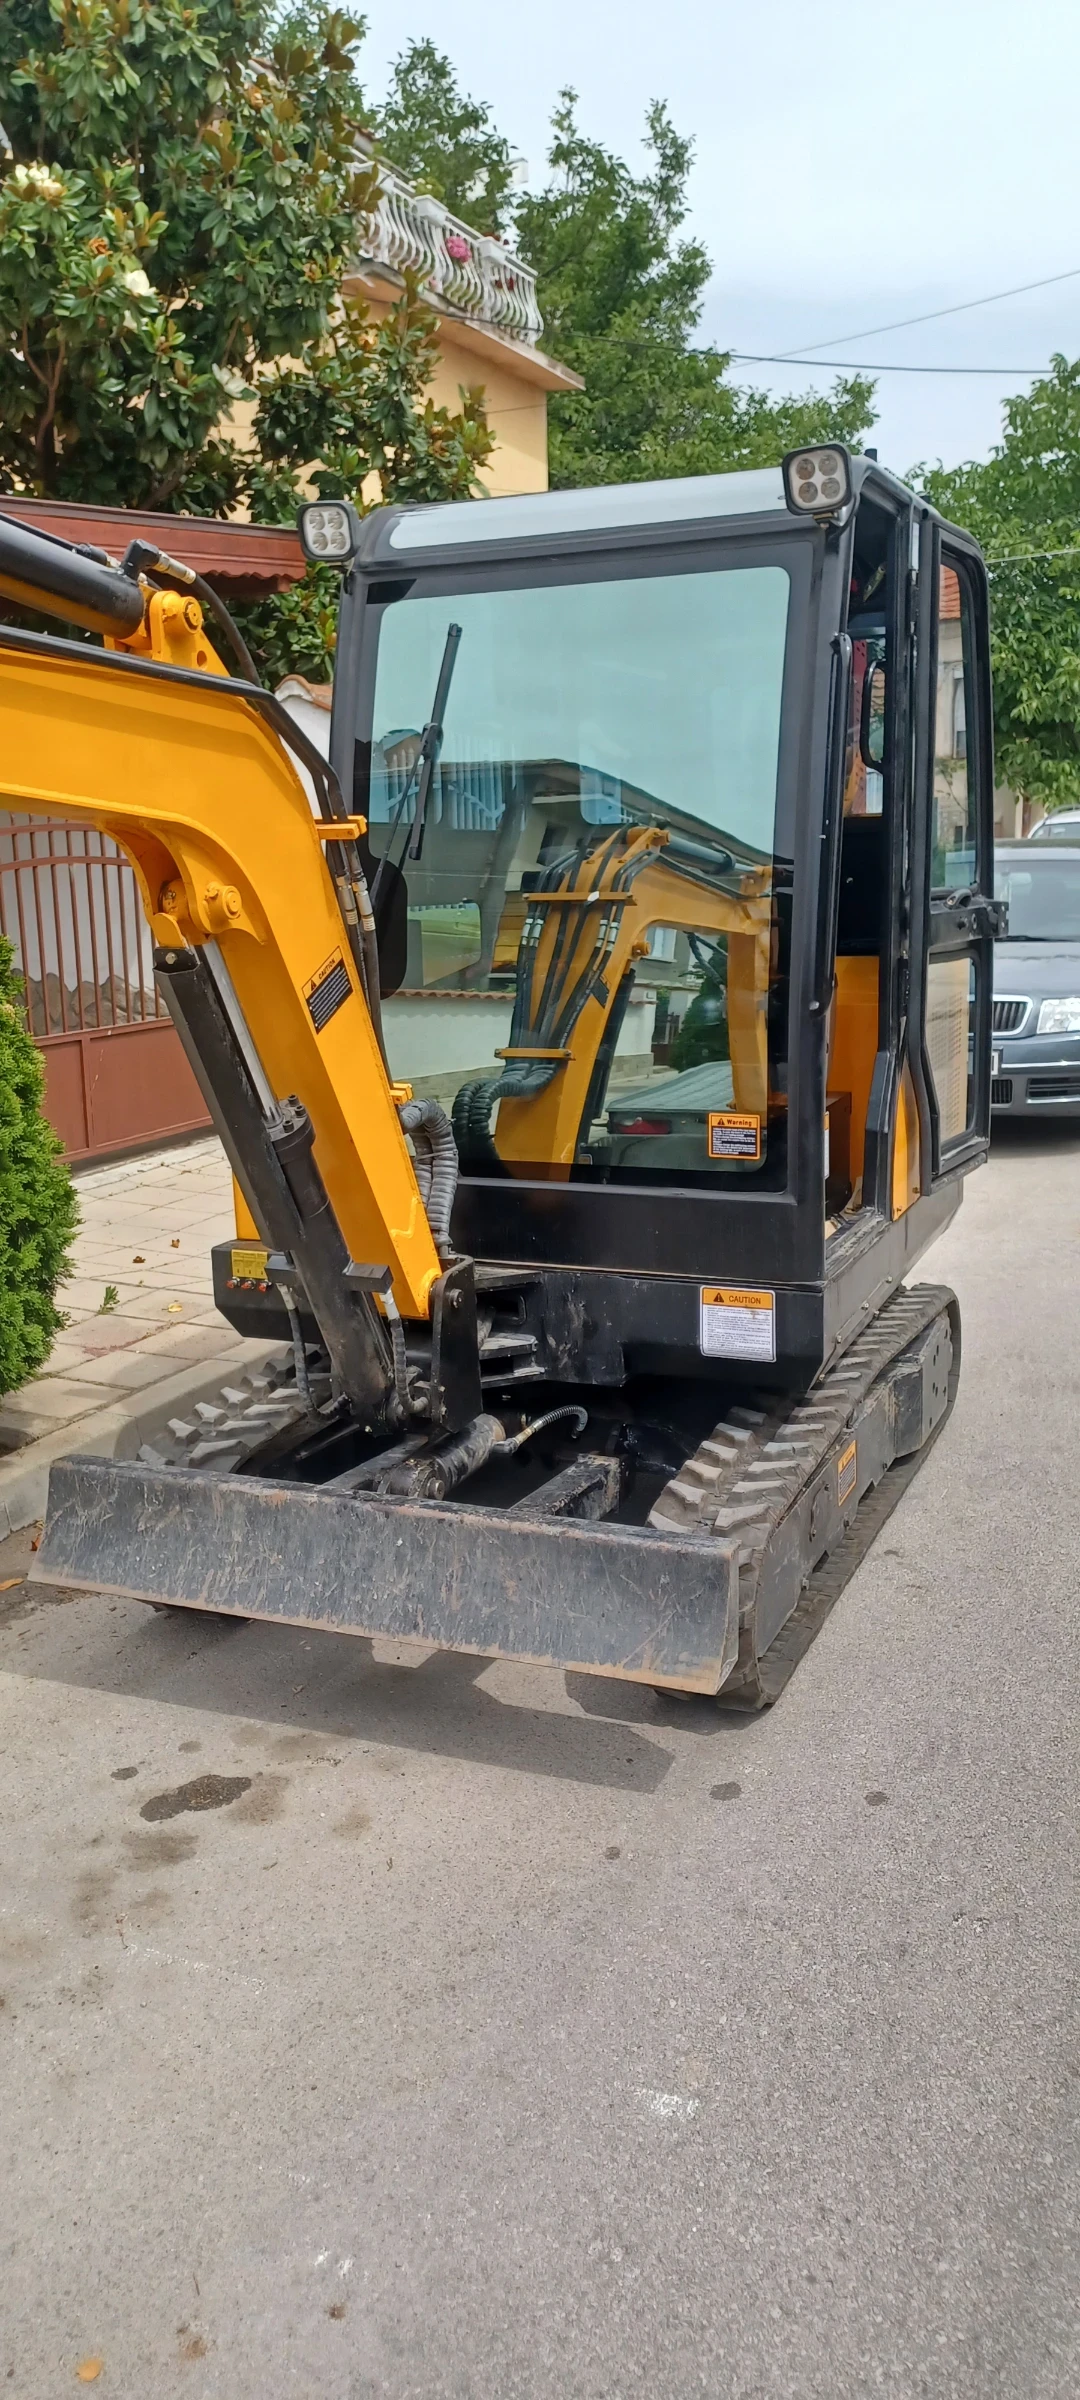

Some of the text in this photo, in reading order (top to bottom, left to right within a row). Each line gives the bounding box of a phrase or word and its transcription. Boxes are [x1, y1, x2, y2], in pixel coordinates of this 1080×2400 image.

[318, 958, 336, 980] CAUTION
[727, 1119, 752, 1127] Warning
[728, 1295, 761, 1305] CAUTION
